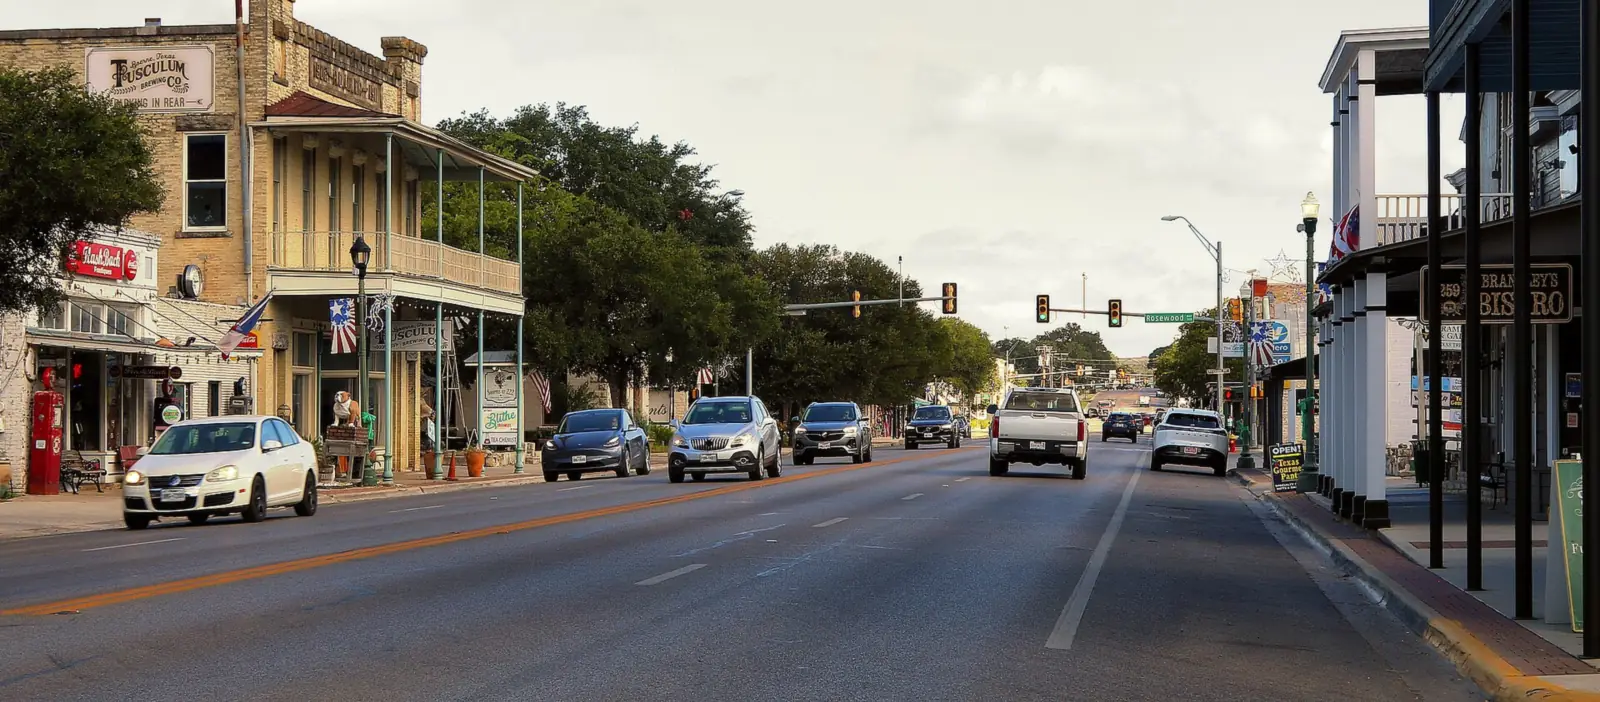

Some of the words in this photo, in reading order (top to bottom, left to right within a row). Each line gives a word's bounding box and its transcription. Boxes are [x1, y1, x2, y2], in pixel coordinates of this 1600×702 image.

[111, 59, 189, 87] TUSCULUM
[140, 76, 166, 90] BREWING
[152, 98, 160, 107] IN
[164, 98, 185, 107] REAR
[1481, 273, 1559, 288] BRANEY'S
[1479, 291, 1564, 316] BISRO
[1146, 314, 1184, 322] Rosewood
[485, 411, 516, 430] Blithe
[1272, 444, 1301, 455] OPEN!
[1279, 459, 1299, 467] Texas
[1273, 466, 1302, 474] Gourme
[1281, 472, 1298, 480] Pant
